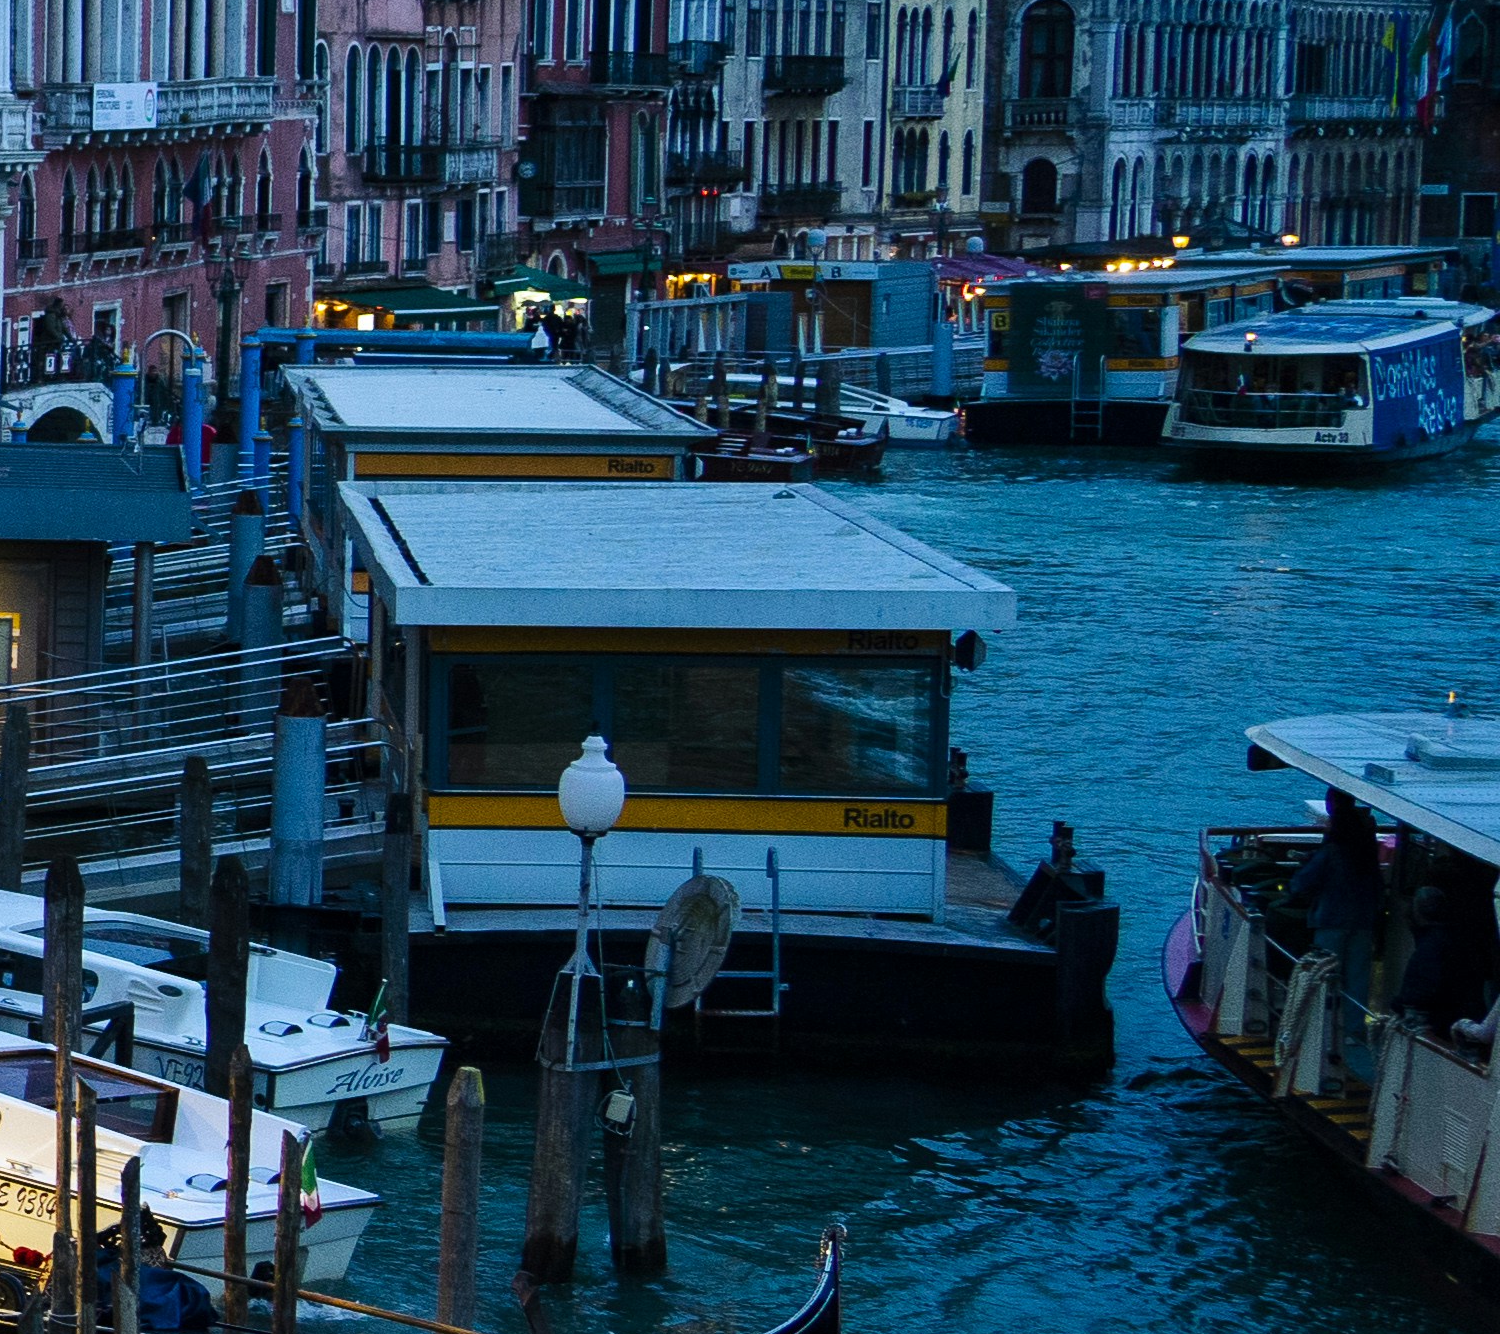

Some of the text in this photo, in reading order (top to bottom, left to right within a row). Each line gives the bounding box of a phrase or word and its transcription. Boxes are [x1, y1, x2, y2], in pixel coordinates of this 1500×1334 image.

[760, 267, 772, 278] A
[831, 266, 842, 278] B
[994, 314, 1006, 327] B
[608, 458, 655, 474] Rialto
[847, 631, 919, 650] Rialto
[844, 807, 915, 830] Rialto
[156, 1056, 205, 1091] VE92
[326, 1062, 404, 1094] Alvise
